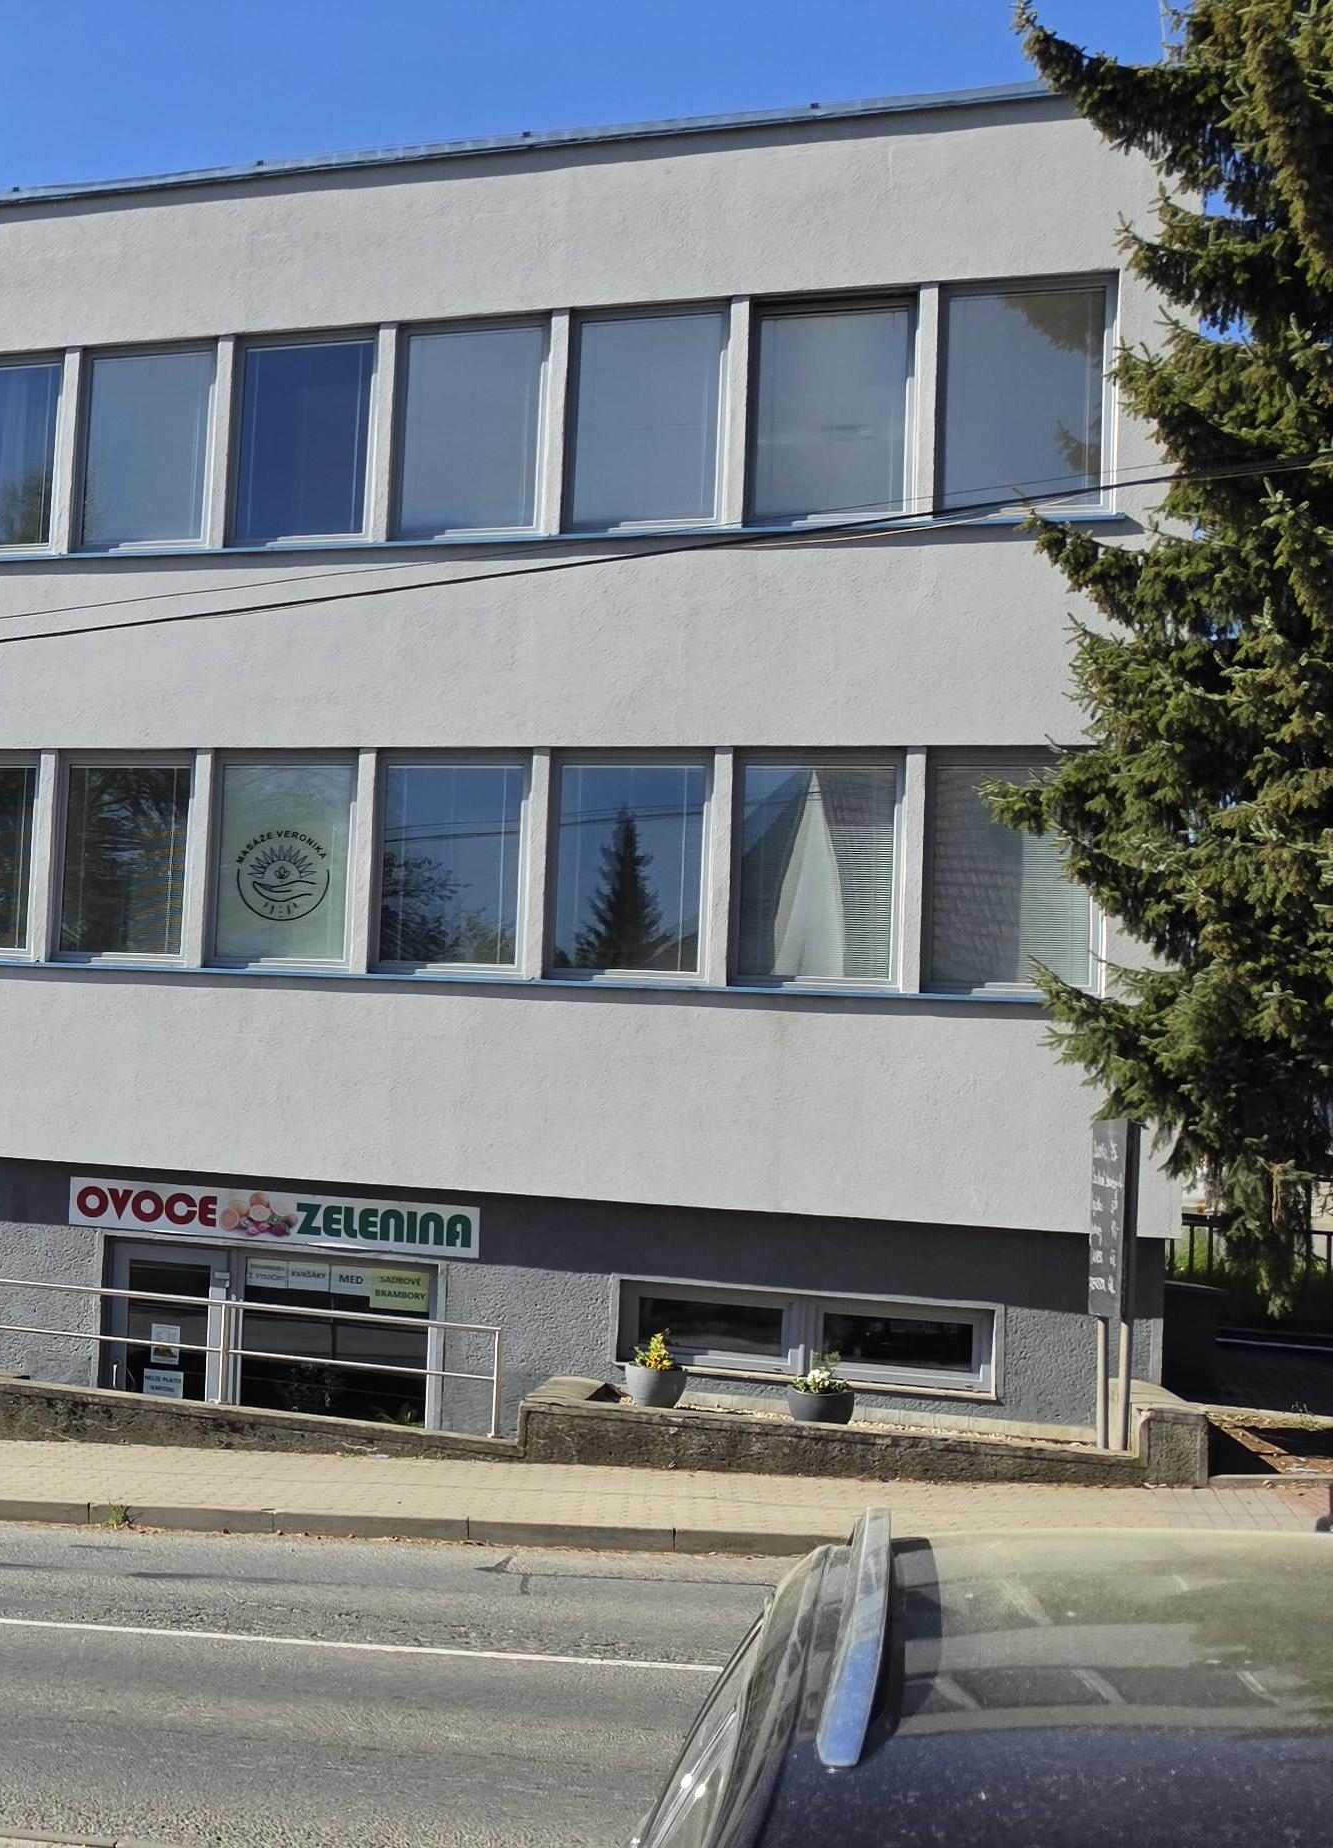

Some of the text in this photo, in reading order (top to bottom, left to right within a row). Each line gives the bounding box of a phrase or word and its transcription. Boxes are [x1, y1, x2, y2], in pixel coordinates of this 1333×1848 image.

[276, 830, 327, 860] VERONIKA
[76, 1185, 472, 1248] OVOCE ZELENINA
[339, 1274, 364, 1285] MED
[379, 1275, 421, 1287] SADBOVÉ
[375, 1289, 426, 1301] BRAMBORY
